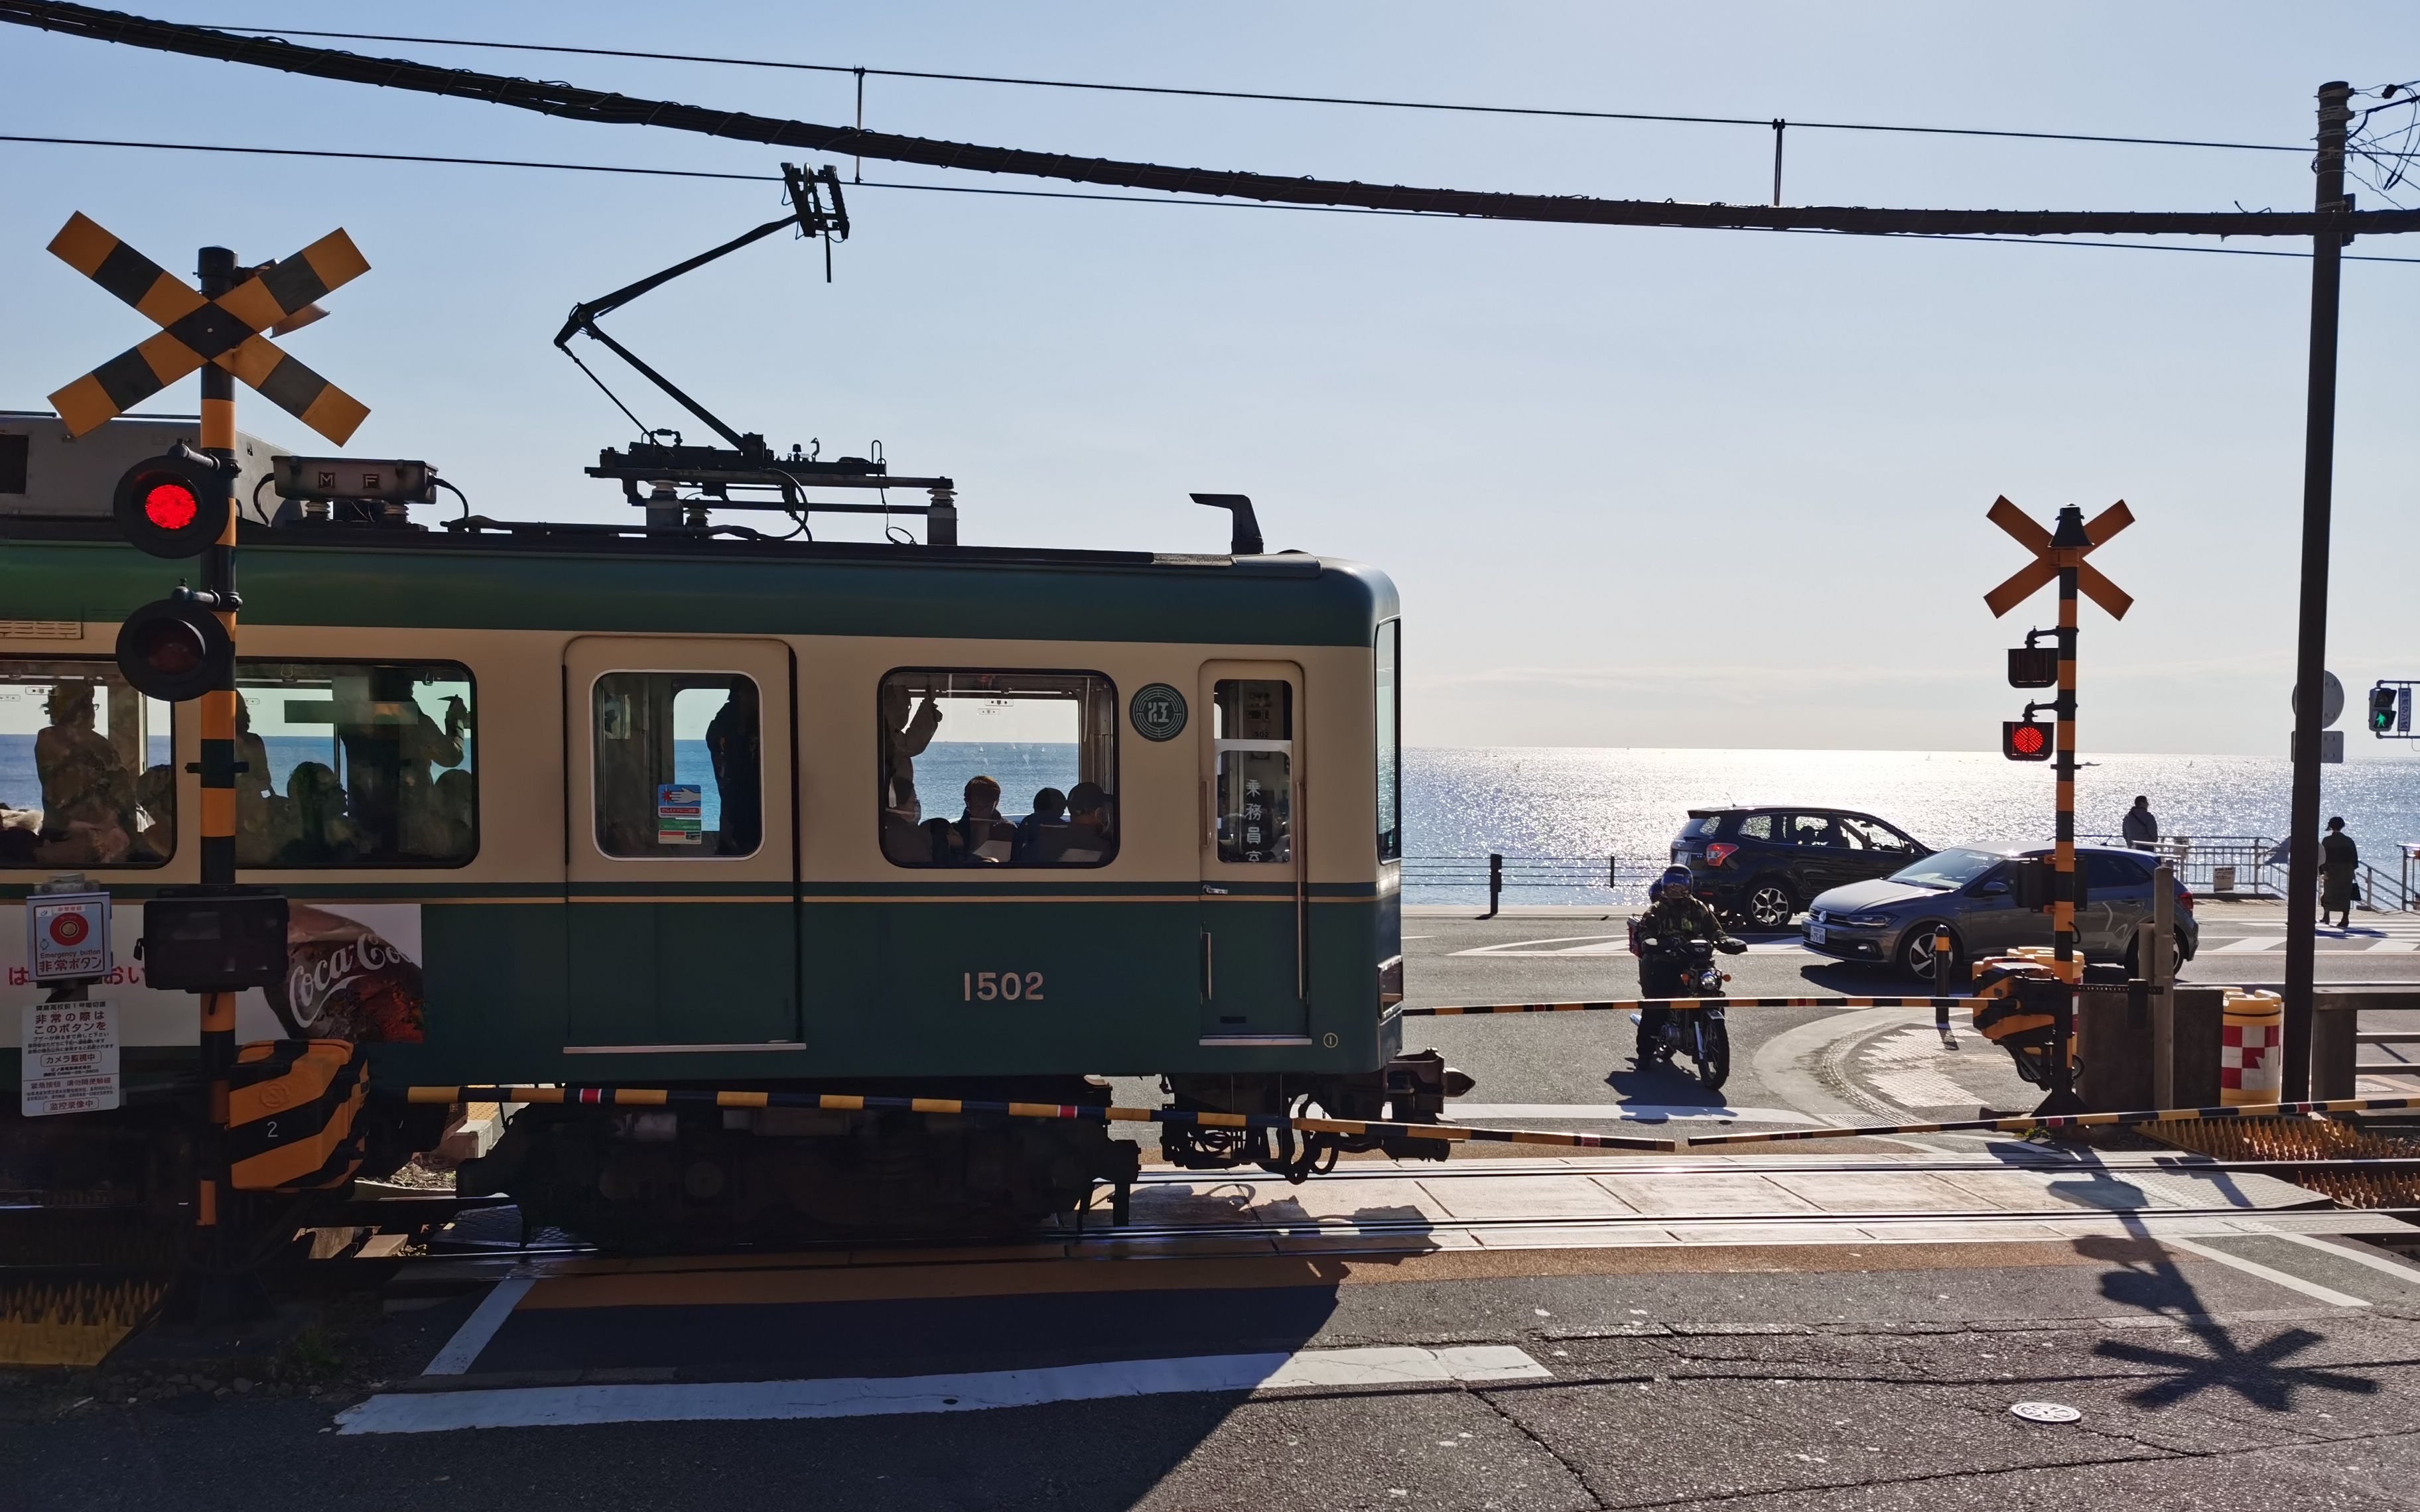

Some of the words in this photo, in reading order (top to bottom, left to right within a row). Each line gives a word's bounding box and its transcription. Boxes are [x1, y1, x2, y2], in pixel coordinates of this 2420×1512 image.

[320, 473, 334, 487] M
[364, 475, 377, 488] F
[40, 950, 77, 959] Emergency
[38, 957, 101, 972] 非常ボタン
[289, 932, 412, 1028] Coca-Co
[964, 972, 1044, 1001] 1502
[35, 1011, 105, 1025] 非常の際は
[34, 1021, 106, 1035] このボタンを
[46, 1053, 96, 1064] カメラ監視中
[266, 1121, 279, 1138] 2
